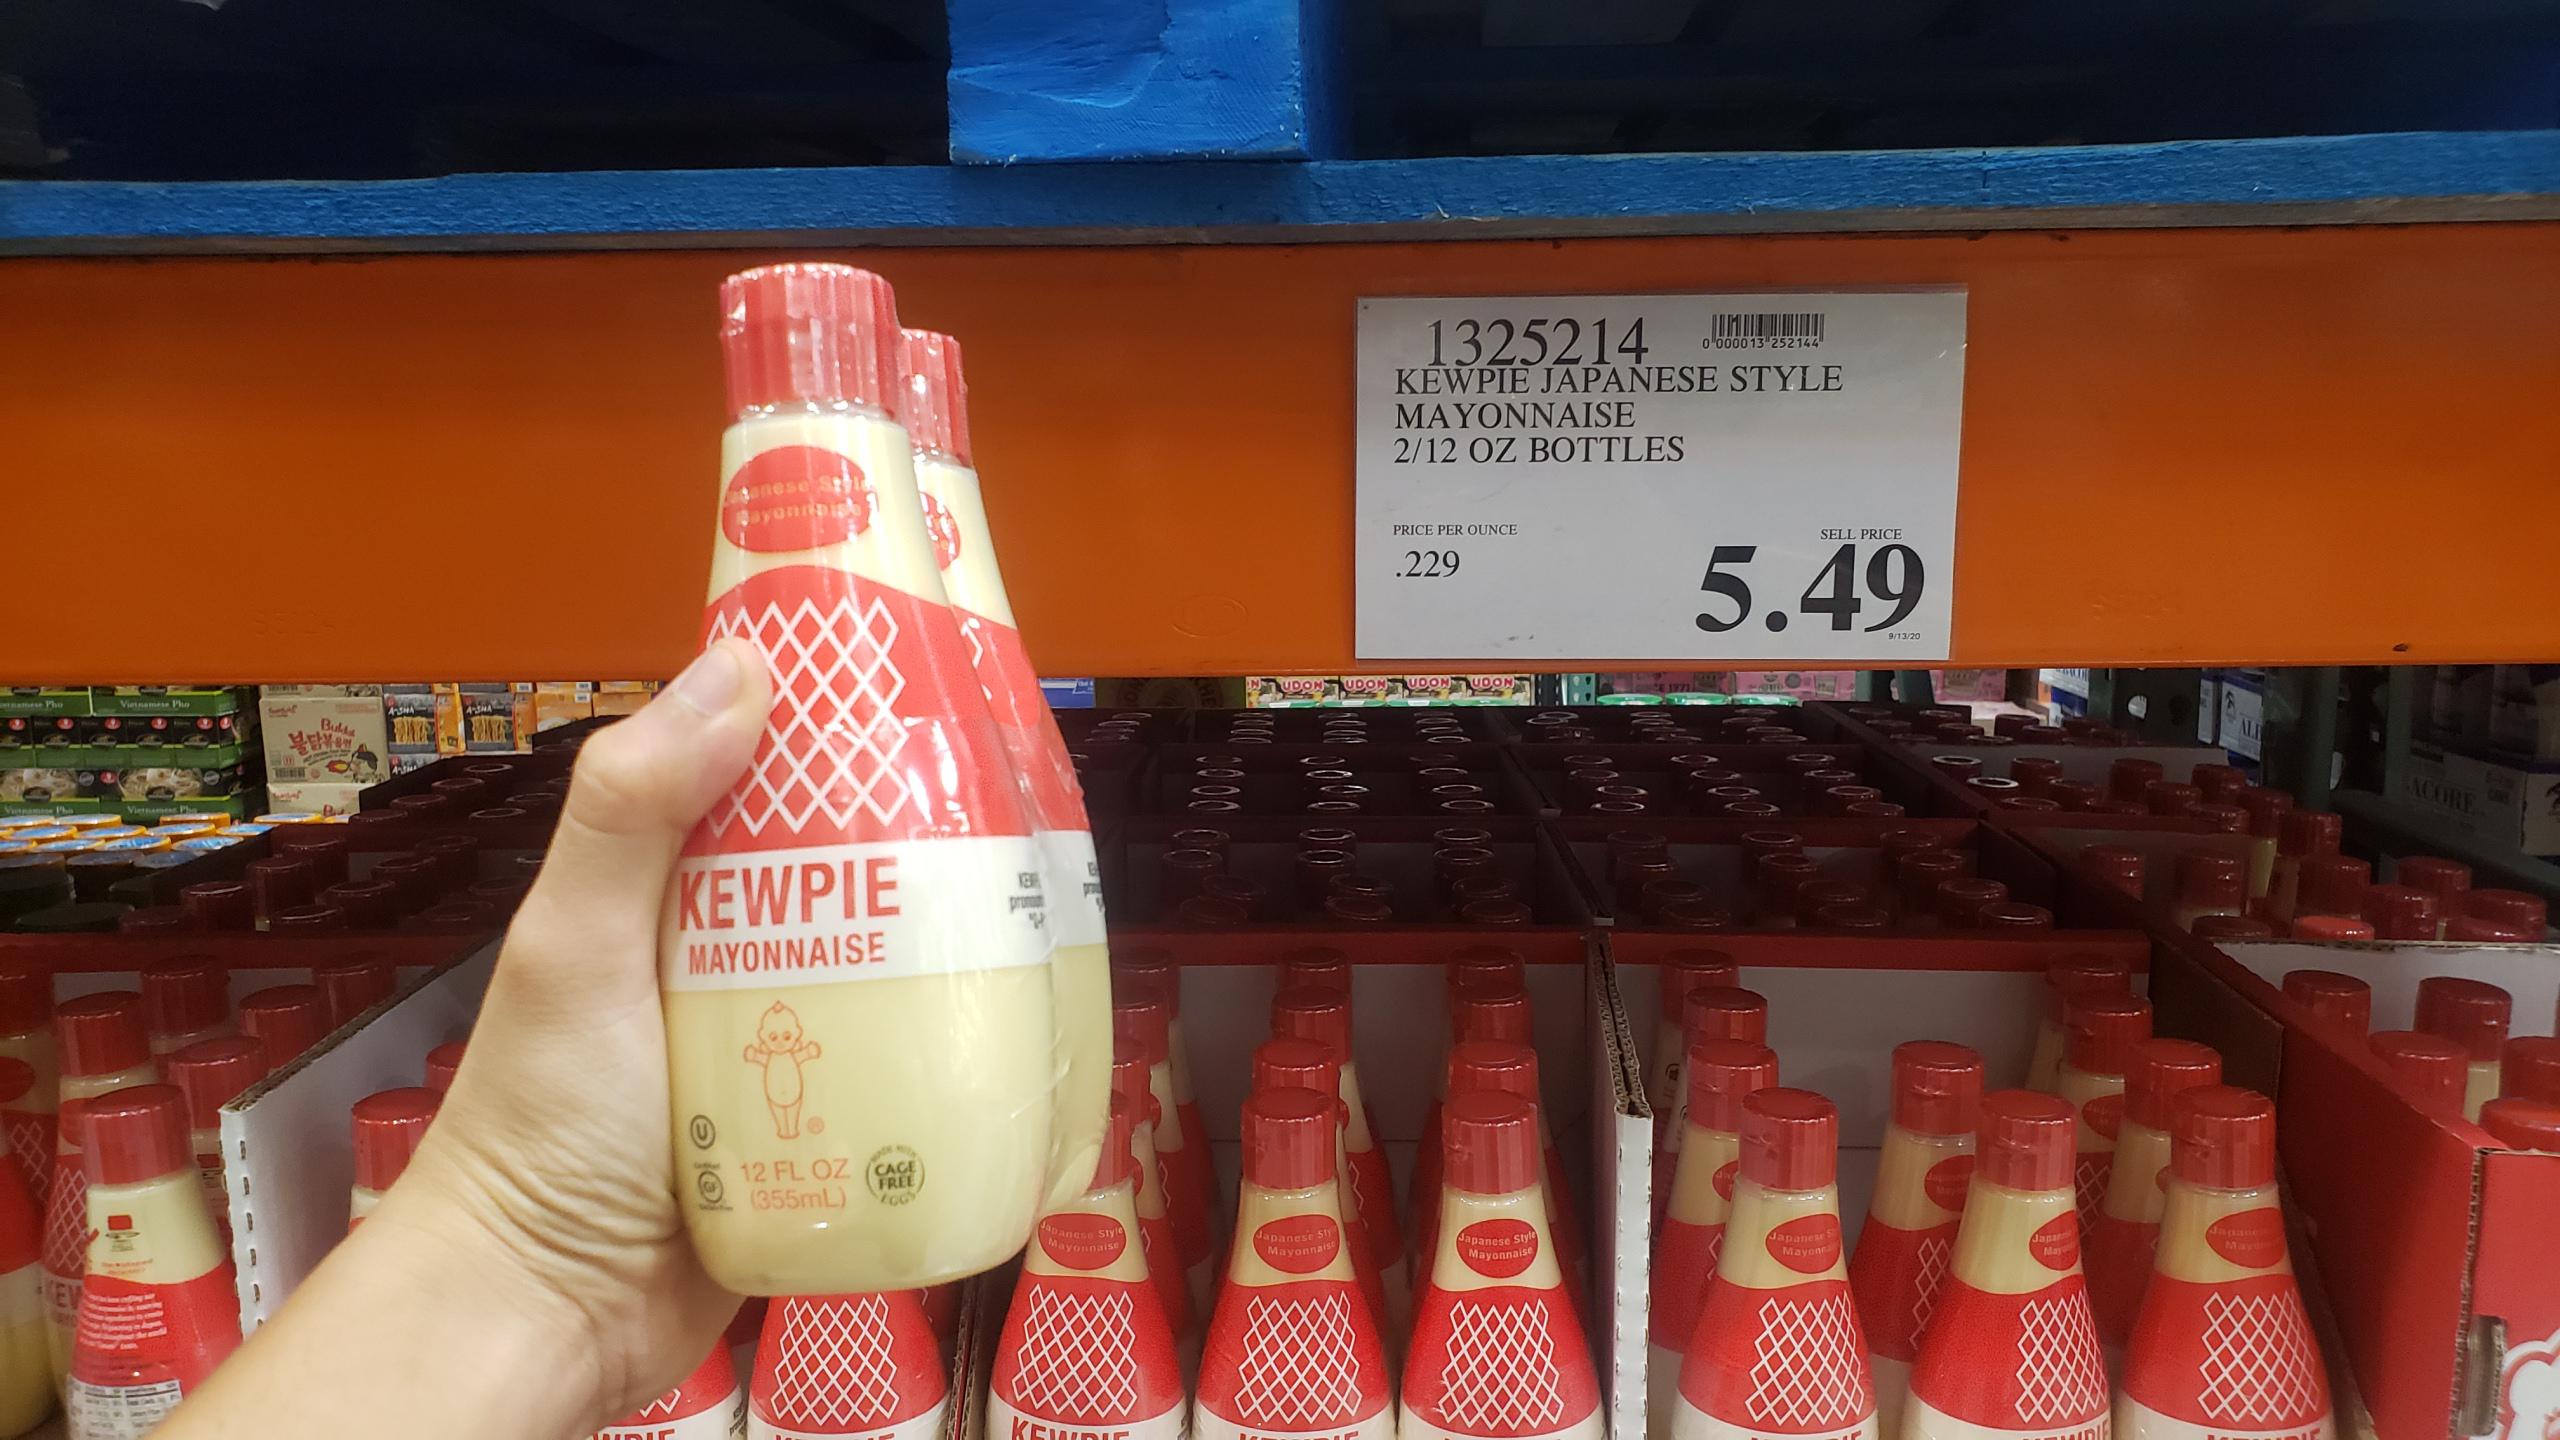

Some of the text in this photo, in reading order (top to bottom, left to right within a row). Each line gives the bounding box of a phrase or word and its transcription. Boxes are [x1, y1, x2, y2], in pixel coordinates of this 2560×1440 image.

[1427, 316, 1649, 367] 1325214
[1771, 338, 1819, 349] 252144
[1394, 365, 1843, 395] KEWPIE JAPANESE STYLE
[1394, 402, 1636, 429] MAYONNAISE
[1393, 436, 1685, 464] 2/12 OZ BOTTLES
[1393, 524, 1518, 536] PRICE PER OUNCE
[1820, 528, 1903, 541] SELL PRICE
[1395, 550, 1461, 578] .229
[1695, 543, 1925, 633] 5.49
[1888, 632, 1921, 641] 9/13/20
[1282, 680, 1324, 691] UDON
[1344, 679, 1387, 690] UDON
[1408, 677, 1450, 688] UDON
[1471, 677, 1514, 688] UDON
[679, 856, 901, 931] KEWPIE
[688, 932, 886, 975] MAYONNAISE
[741, 1158, 851, 1182] 12 FL OZ
[875, 1160, 916, 1176] CAGE
[879, 1175, 915, 1190] FREE
[750, 1187, 847, 1211] (355mL)
[1098, 1226, 1123, 1239] Style
[1255, 1229, 1314, 1243] Japanese
[1458, 1231, 1537, 1246] Japanese Style
[1048, 1237, 1119, 1253] Mayonnaise
[1267, 1240, 1336, 1257] Mayonnaise
[1468, 1246, 1533, 1261] Mayonnaise
